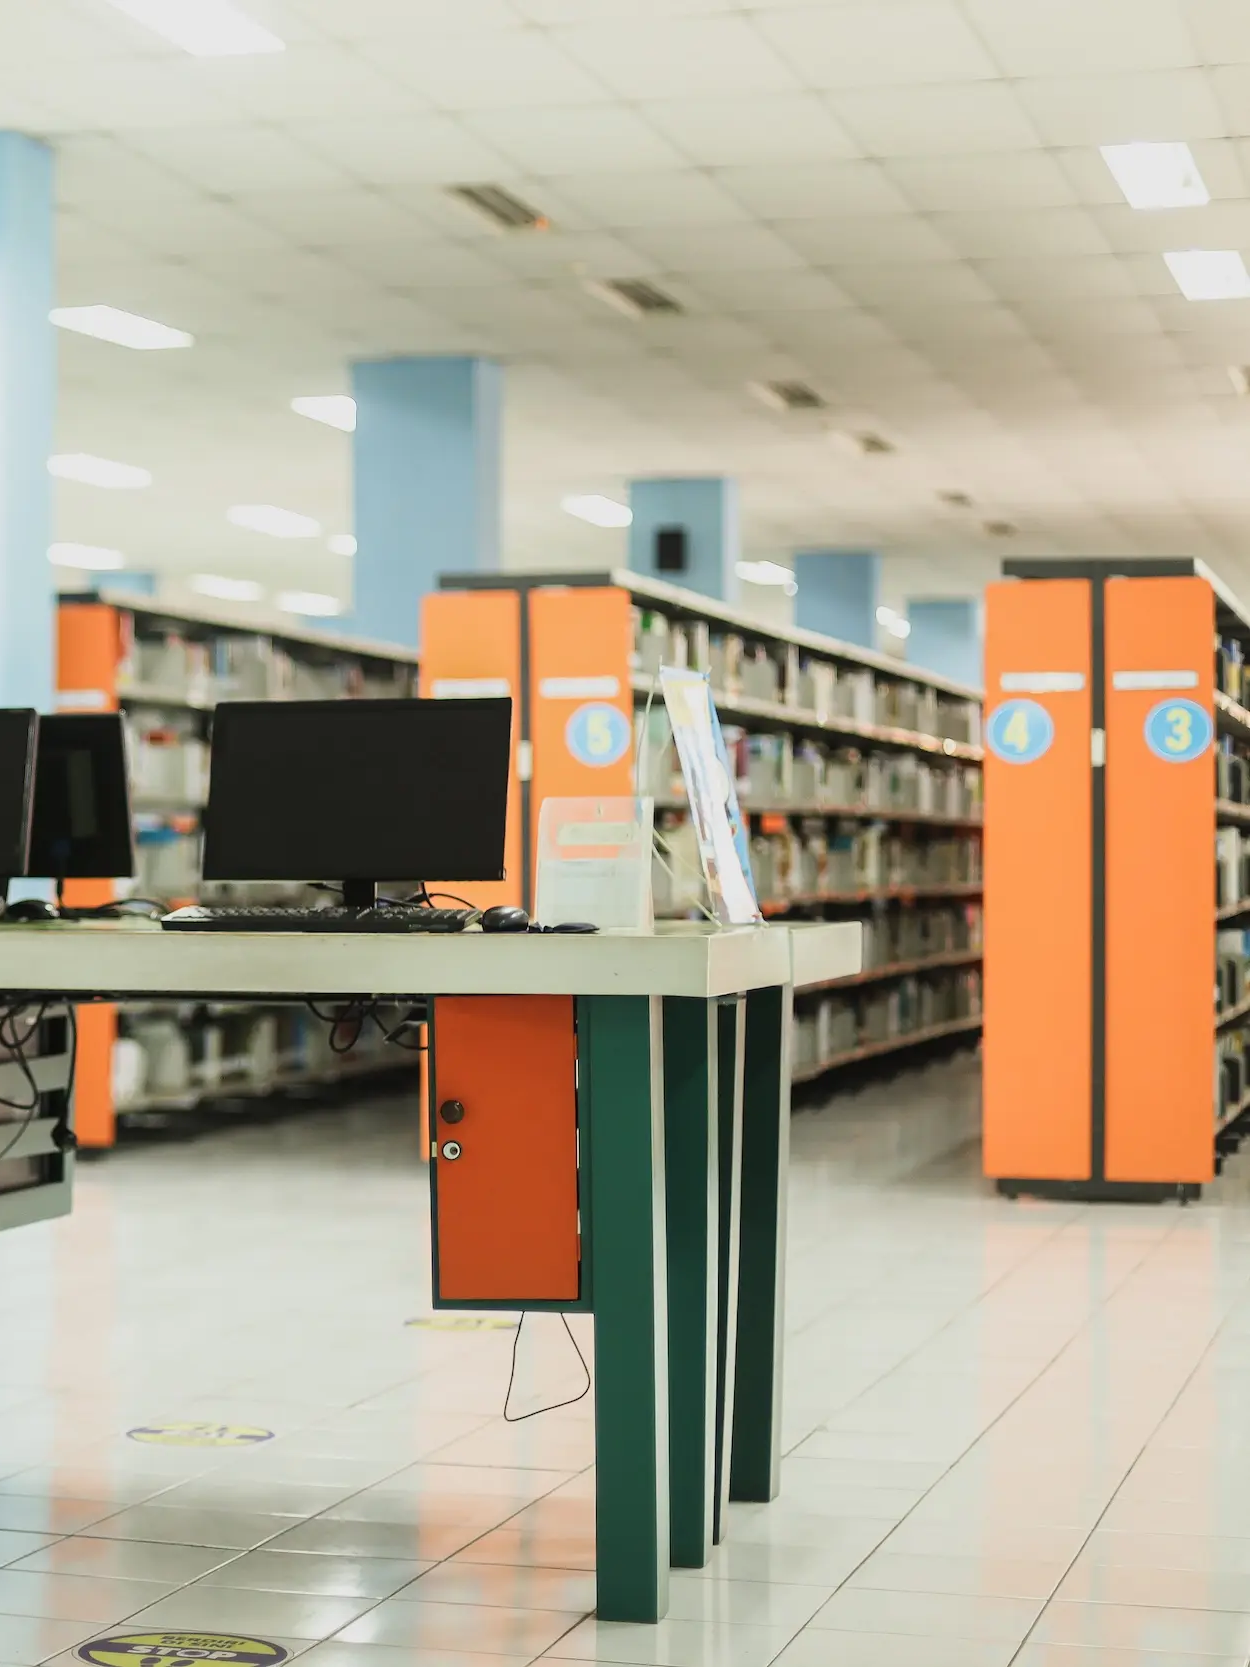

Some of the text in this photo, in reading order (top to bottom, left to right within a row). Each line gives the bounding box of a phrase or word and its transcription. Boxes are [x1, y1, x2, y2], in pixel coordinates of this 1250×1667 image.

[586, 711, 612, 754] 5
[1002, 710, 1029, 752] 4
[1165, 707, 1192, 752] 3
[126, 1645, 238, 1660] STOP
[161, 1635, 246, 1646] BERDIRI
